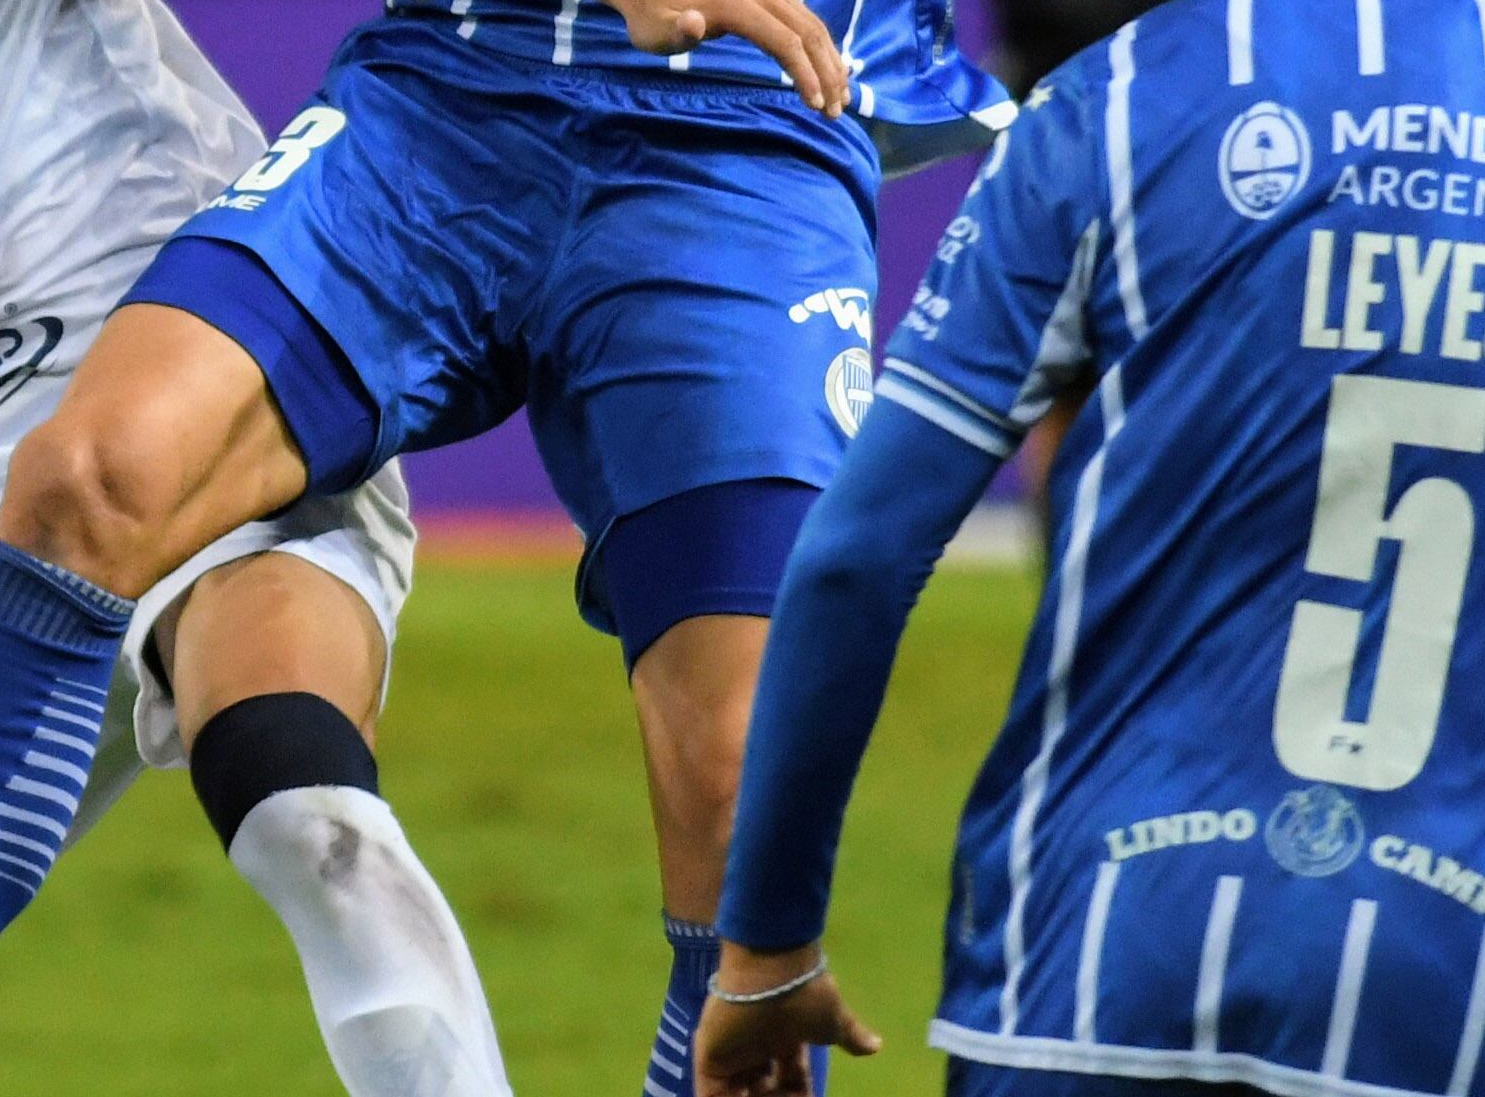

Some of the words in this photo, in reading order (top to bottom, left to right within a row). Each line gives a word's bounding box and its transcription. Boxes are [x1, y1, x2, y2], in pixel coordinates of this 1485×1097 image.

[1273, 373, 1485, 791] 5
[1104, 807, 1257, 862] LINDO
[1368, 834, 1485, 916] CAM
